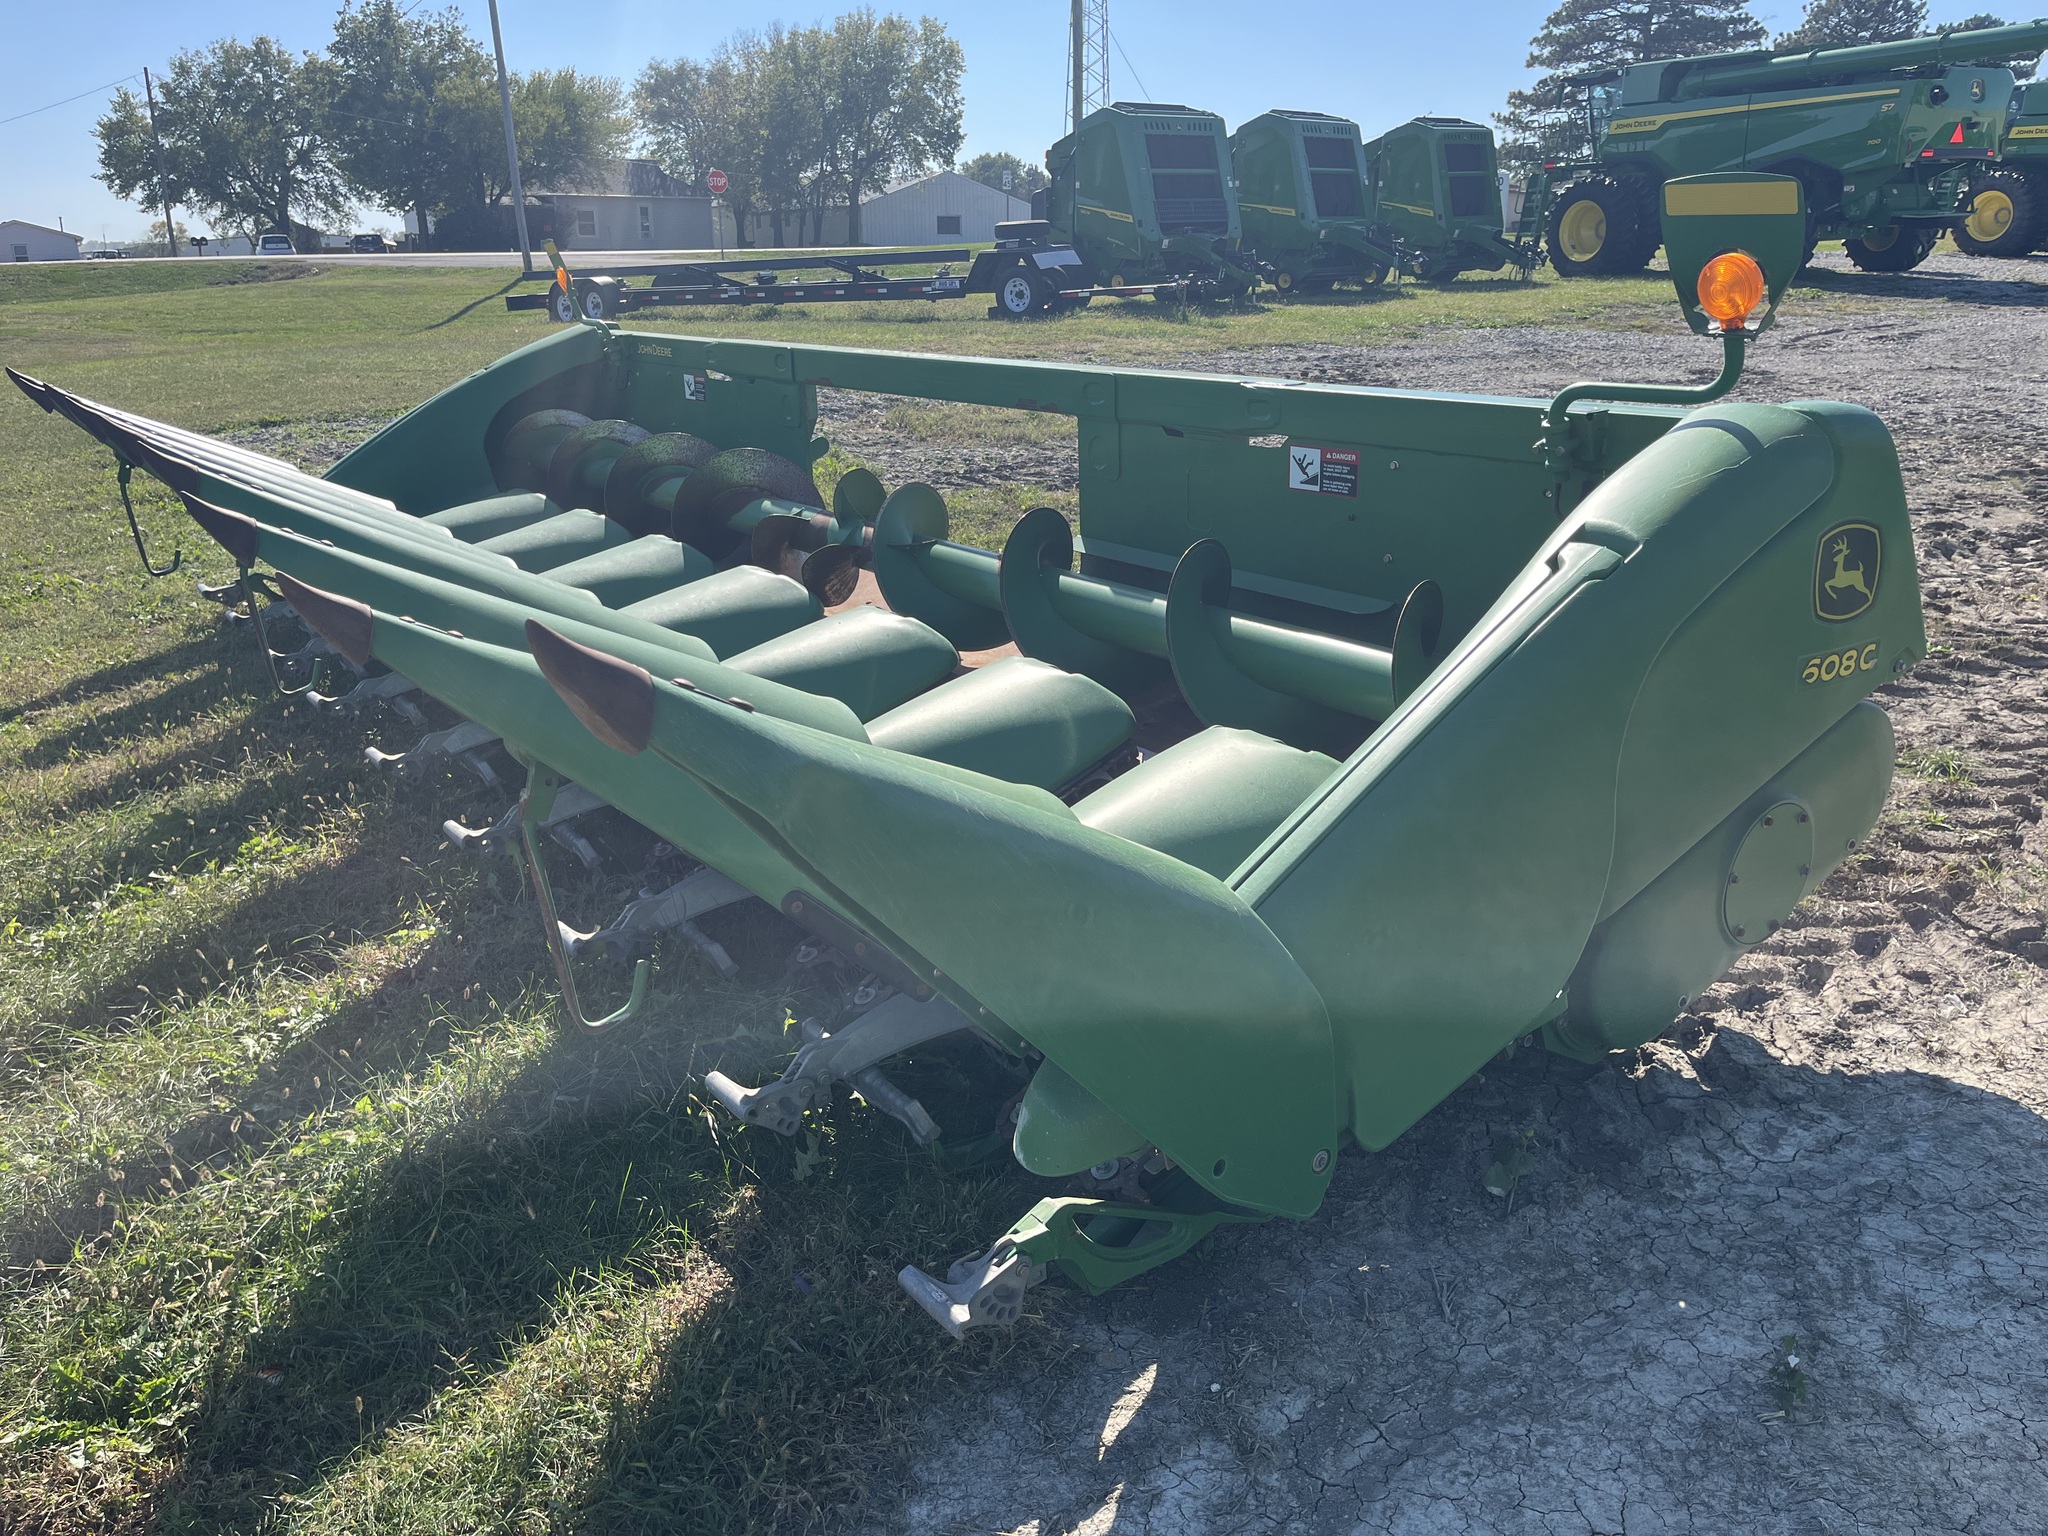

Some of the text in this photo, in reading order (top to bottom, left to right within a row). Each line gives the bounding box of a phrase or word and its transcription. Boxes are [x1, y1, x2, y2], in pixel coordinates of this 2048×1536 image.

[1880, 103, 1895, 112] S7
[709, 177, 726, 186] STOP
[638, 343, 672, 357] JOHN DEERE
[1332, 452, 1356, 461] DANGER
[1802, 643, 1877, 684] 608C
